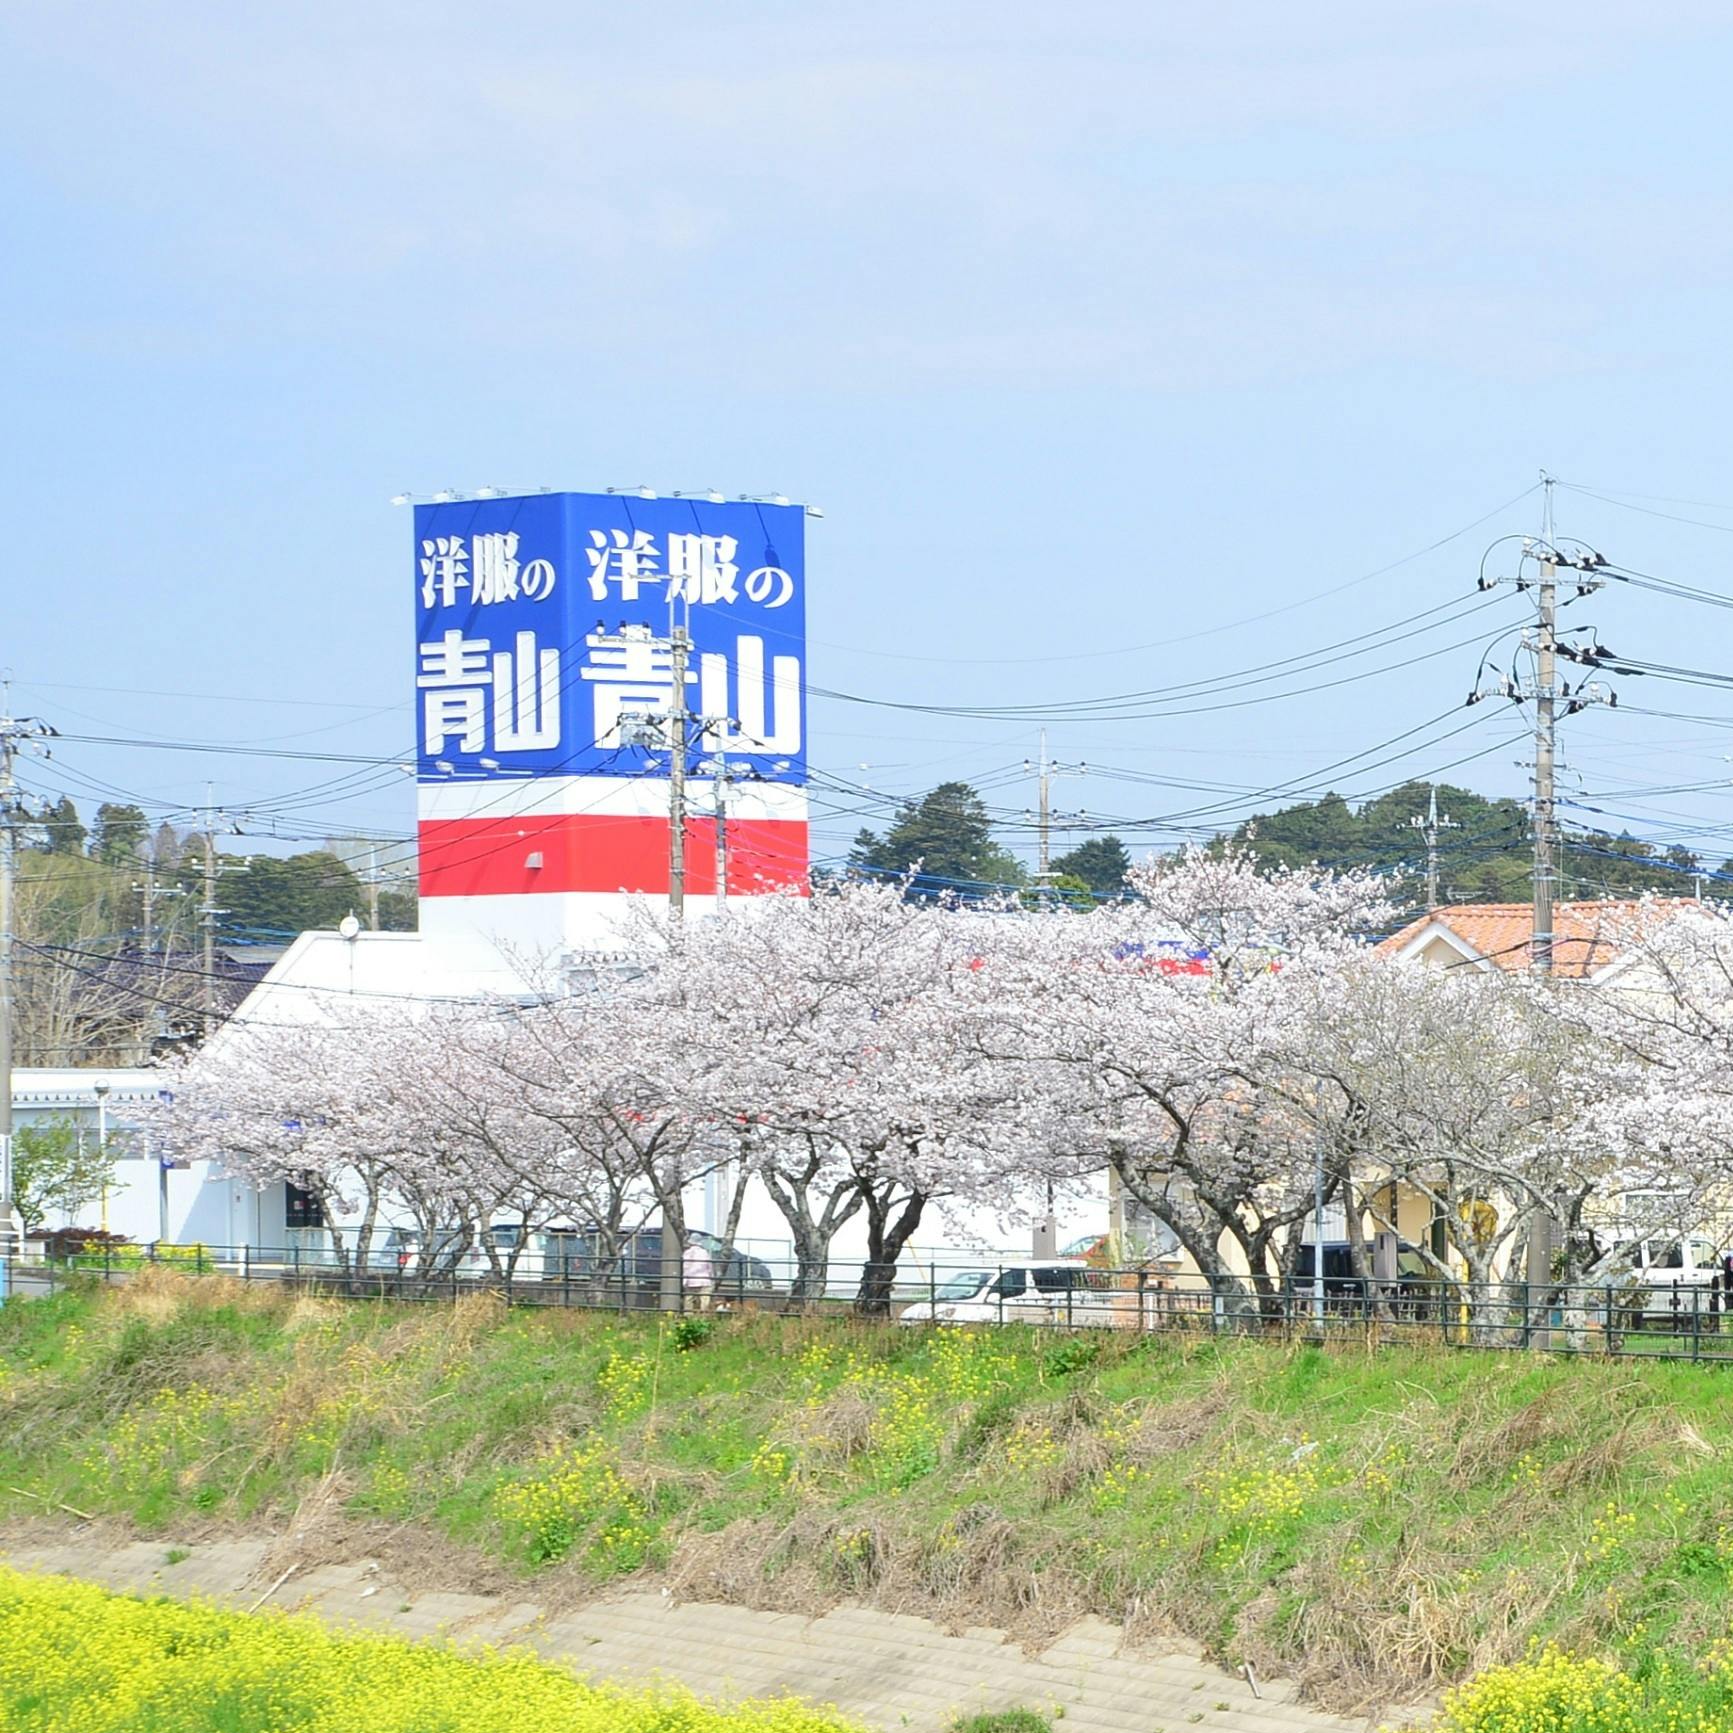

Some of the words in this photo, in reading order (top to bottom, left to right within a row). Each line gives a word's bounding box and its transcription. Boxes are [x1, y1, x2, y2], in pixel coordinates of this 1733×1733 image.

[421, 531, 556, 609] 洋服の
[585, 528, 794, 609] 洋服の
[417, 628, 561, 756] 青山
[580, 625, 801, 755] 青山
